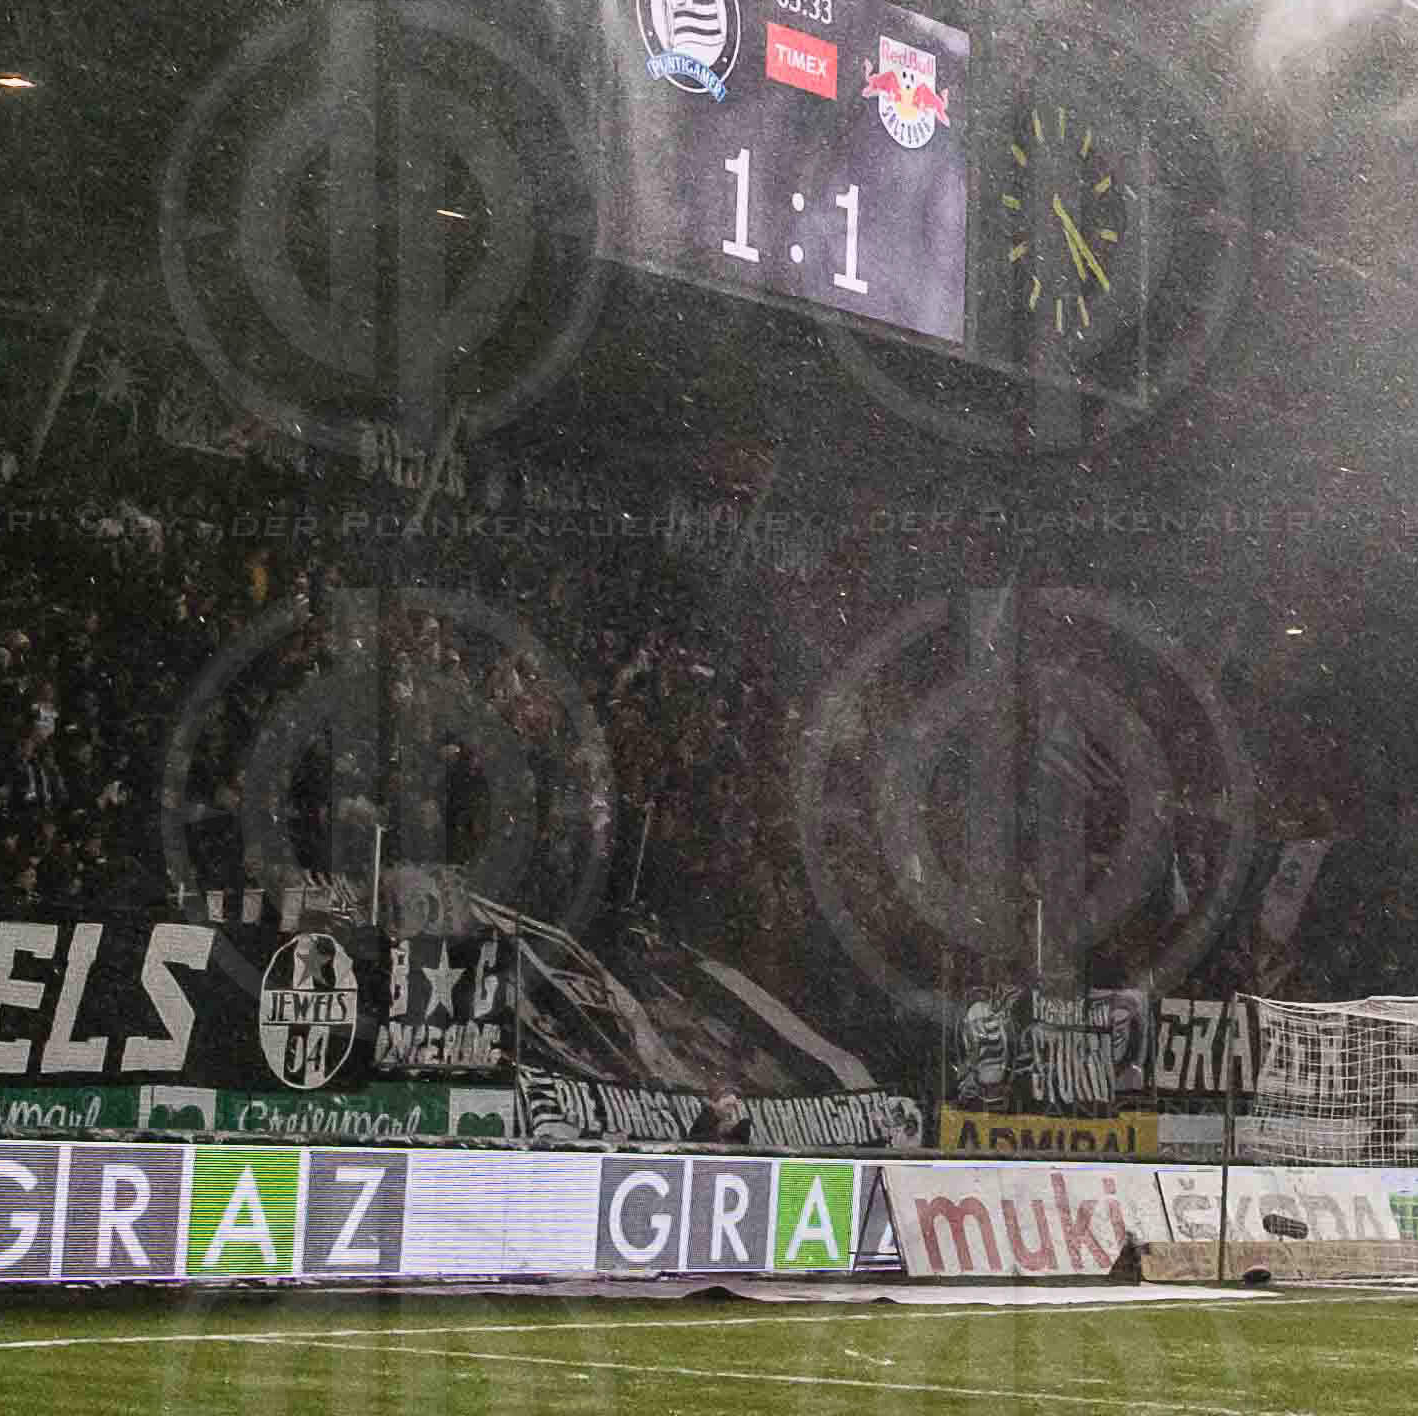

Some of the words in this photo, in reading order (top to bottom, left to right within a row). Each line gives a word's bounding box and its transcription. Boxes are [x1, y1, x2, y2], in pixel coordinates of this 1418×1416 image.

[775, 44, 827, 78] TIMEX
[267, 991, 347, 1022] JEWELS
[608, 1170, 901, 1262] GRA
[915, 1172, 1125, 1274] muki
